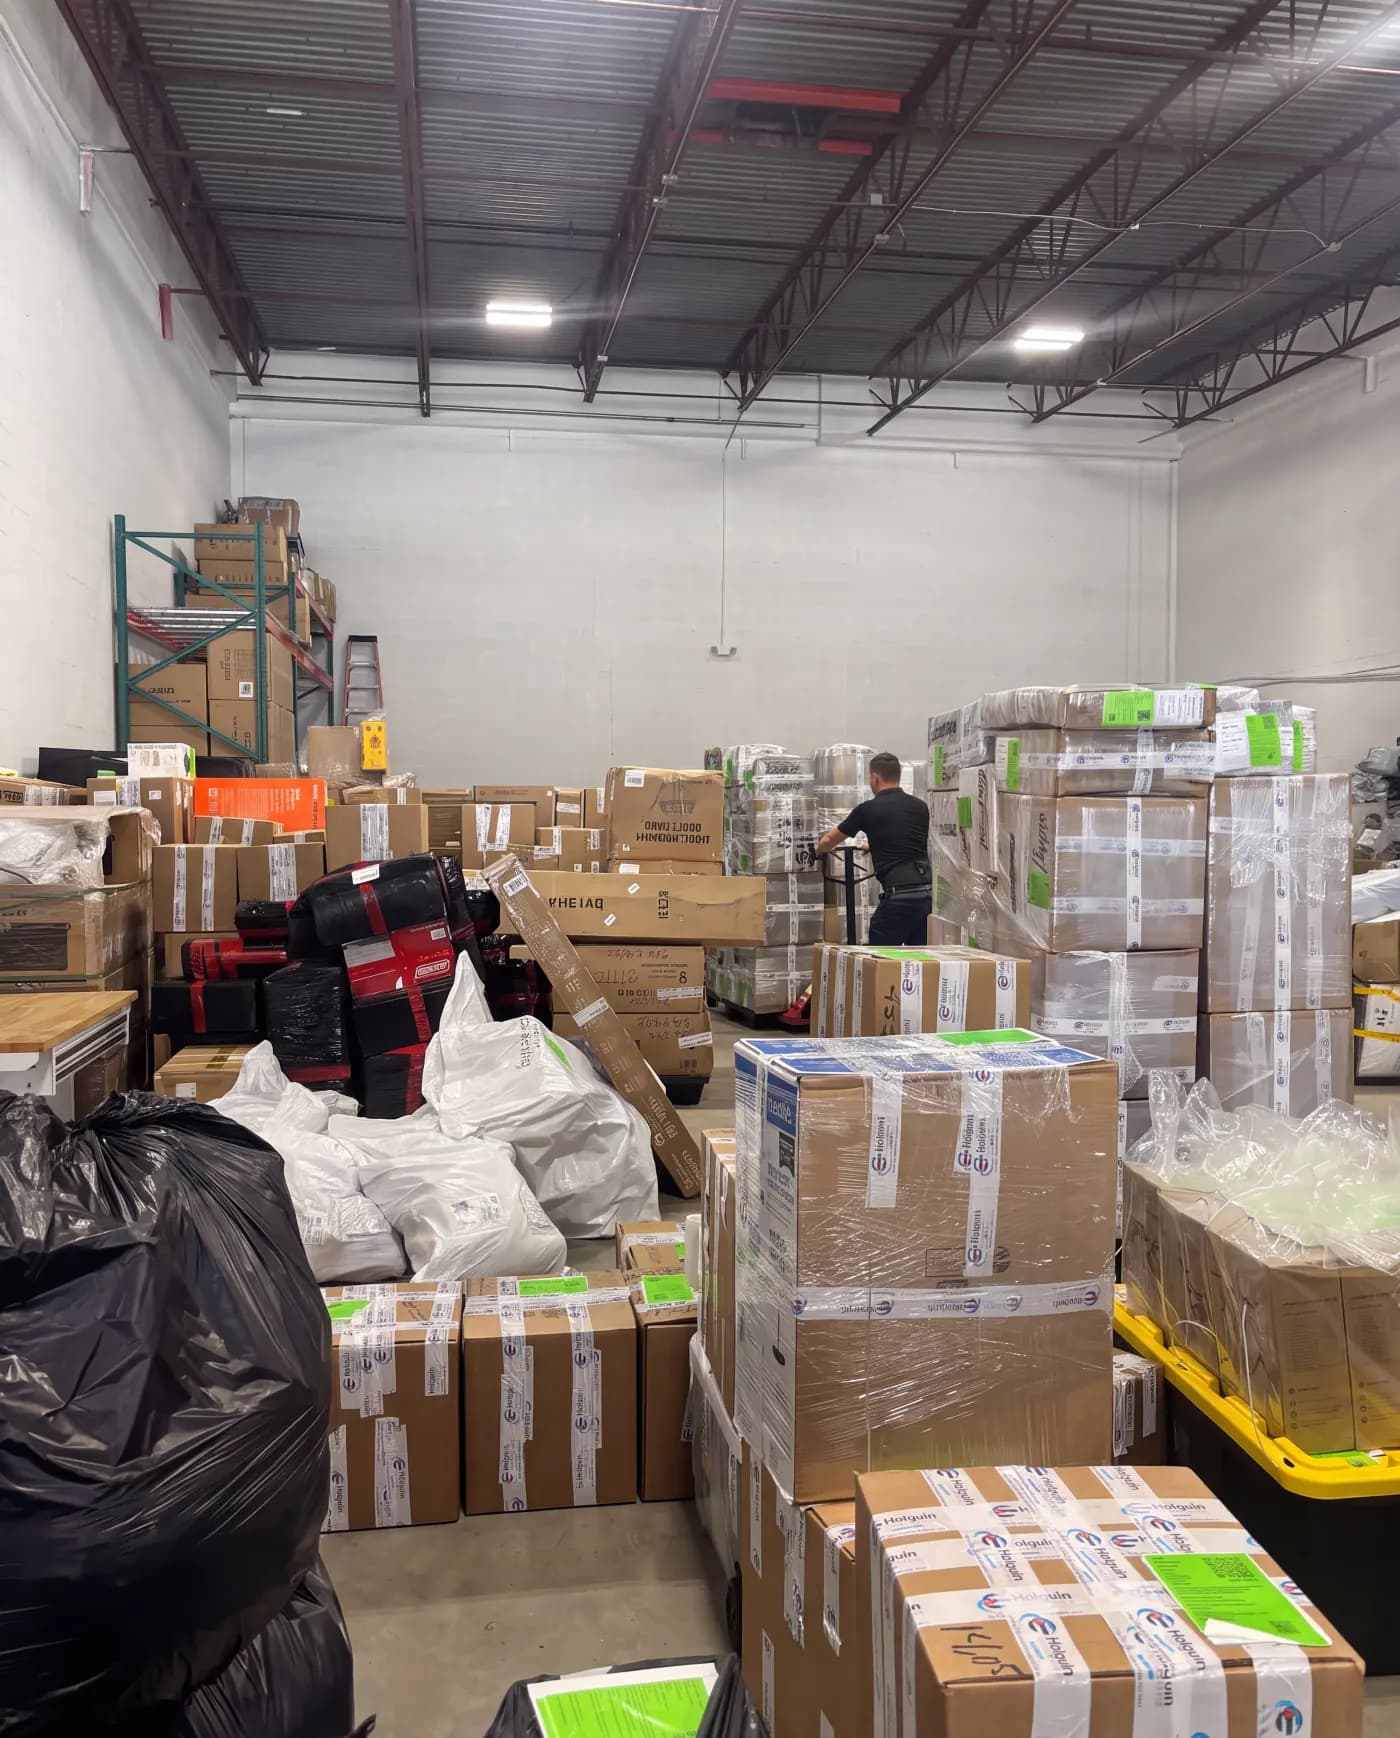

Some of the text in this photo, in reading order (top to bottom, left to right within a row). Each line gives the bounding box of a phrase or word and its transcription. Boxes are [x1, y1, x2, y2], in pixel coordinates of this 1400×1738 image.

[951, 1478, 975, 1507] Holguin
[883, 1511, 937, 1526] Holguin
[889, 1548, 917, 1563] guin
[1014, 1537, 1053, 1549] olgui
[998, 1548, 1024, 1582] Holguin
[1094, 1547, 1128, 1580] Holguin
[1046, 1636, 1076, 1677] Holguin
[1168, 1629, 1207, 1672] Holguin
